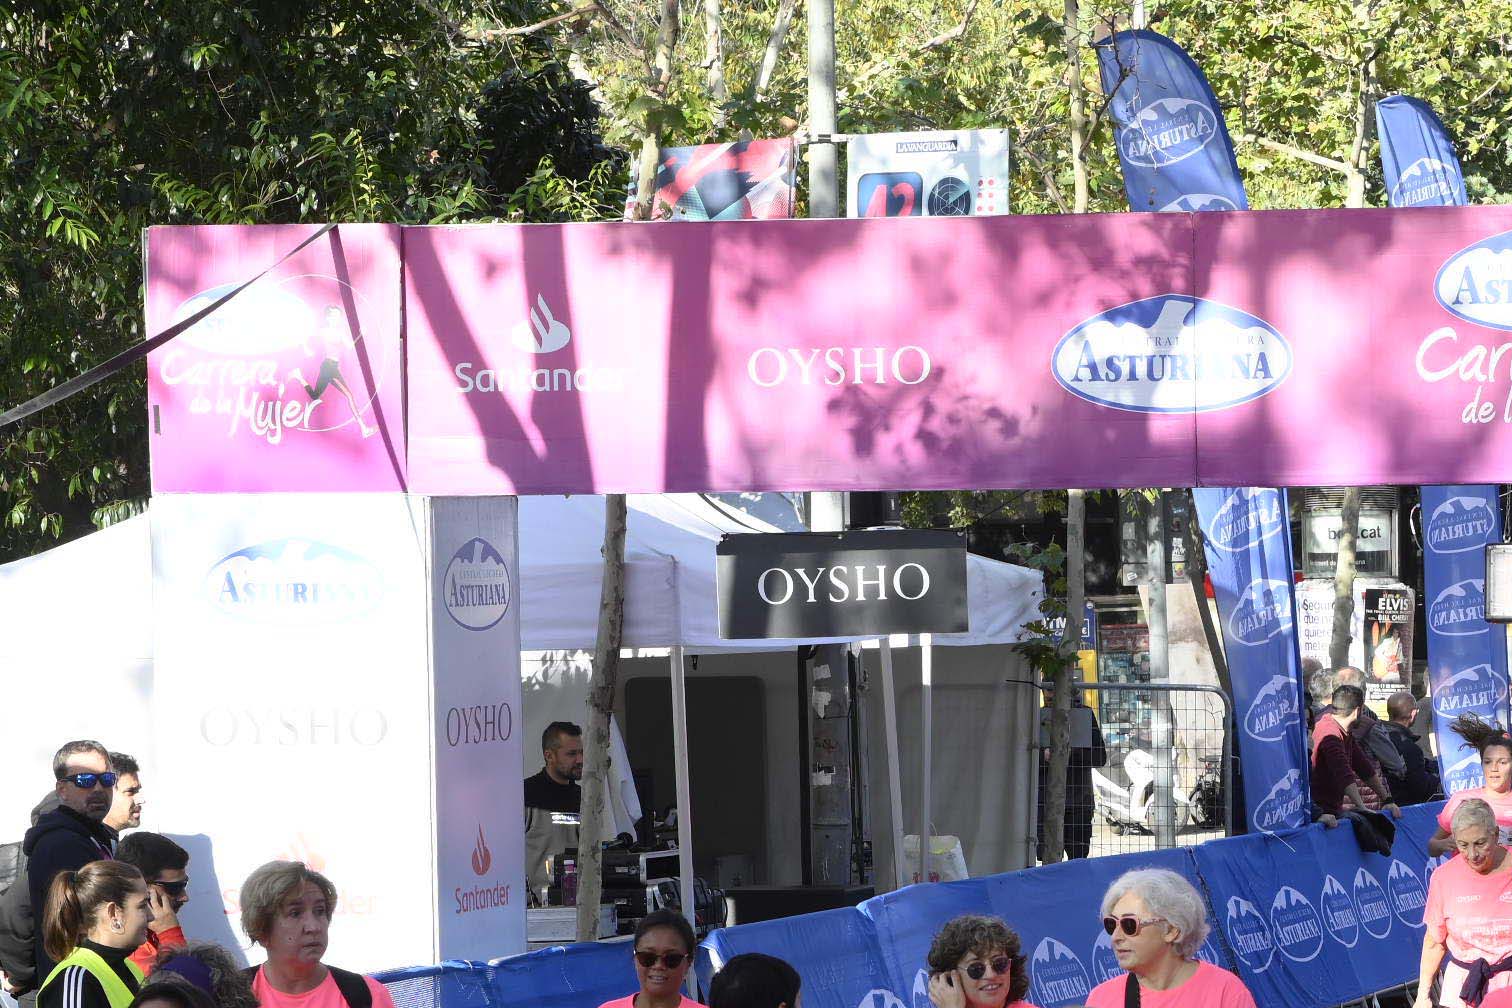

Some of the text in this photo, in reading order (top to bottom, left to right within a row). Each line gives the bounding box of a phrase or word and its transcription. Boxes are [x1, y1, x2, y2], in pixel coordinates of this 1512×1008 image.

[160, 354, 278, 386] Carrera
[455, 362, 624, 394] Santander
[747, 345, 932, 387] OYSHO
[228, 381, 322, 444] Mujer
[1461, 392, 1494, 424] de
[448, 583, 507, 608] ASTURIANA
[757, 562, 931, 605] OYSHO
[1378, 598, 1409, 611] ELVIS
[200, 703, 389, 748] OYSHO
[446, 702, 513, 747] OYSHO
[454, 882, 511, 914] Santander
[1276, 918, 1320, 946] ASTURIANA
[1039, 975, 1088, 1005] ASTURIANA
